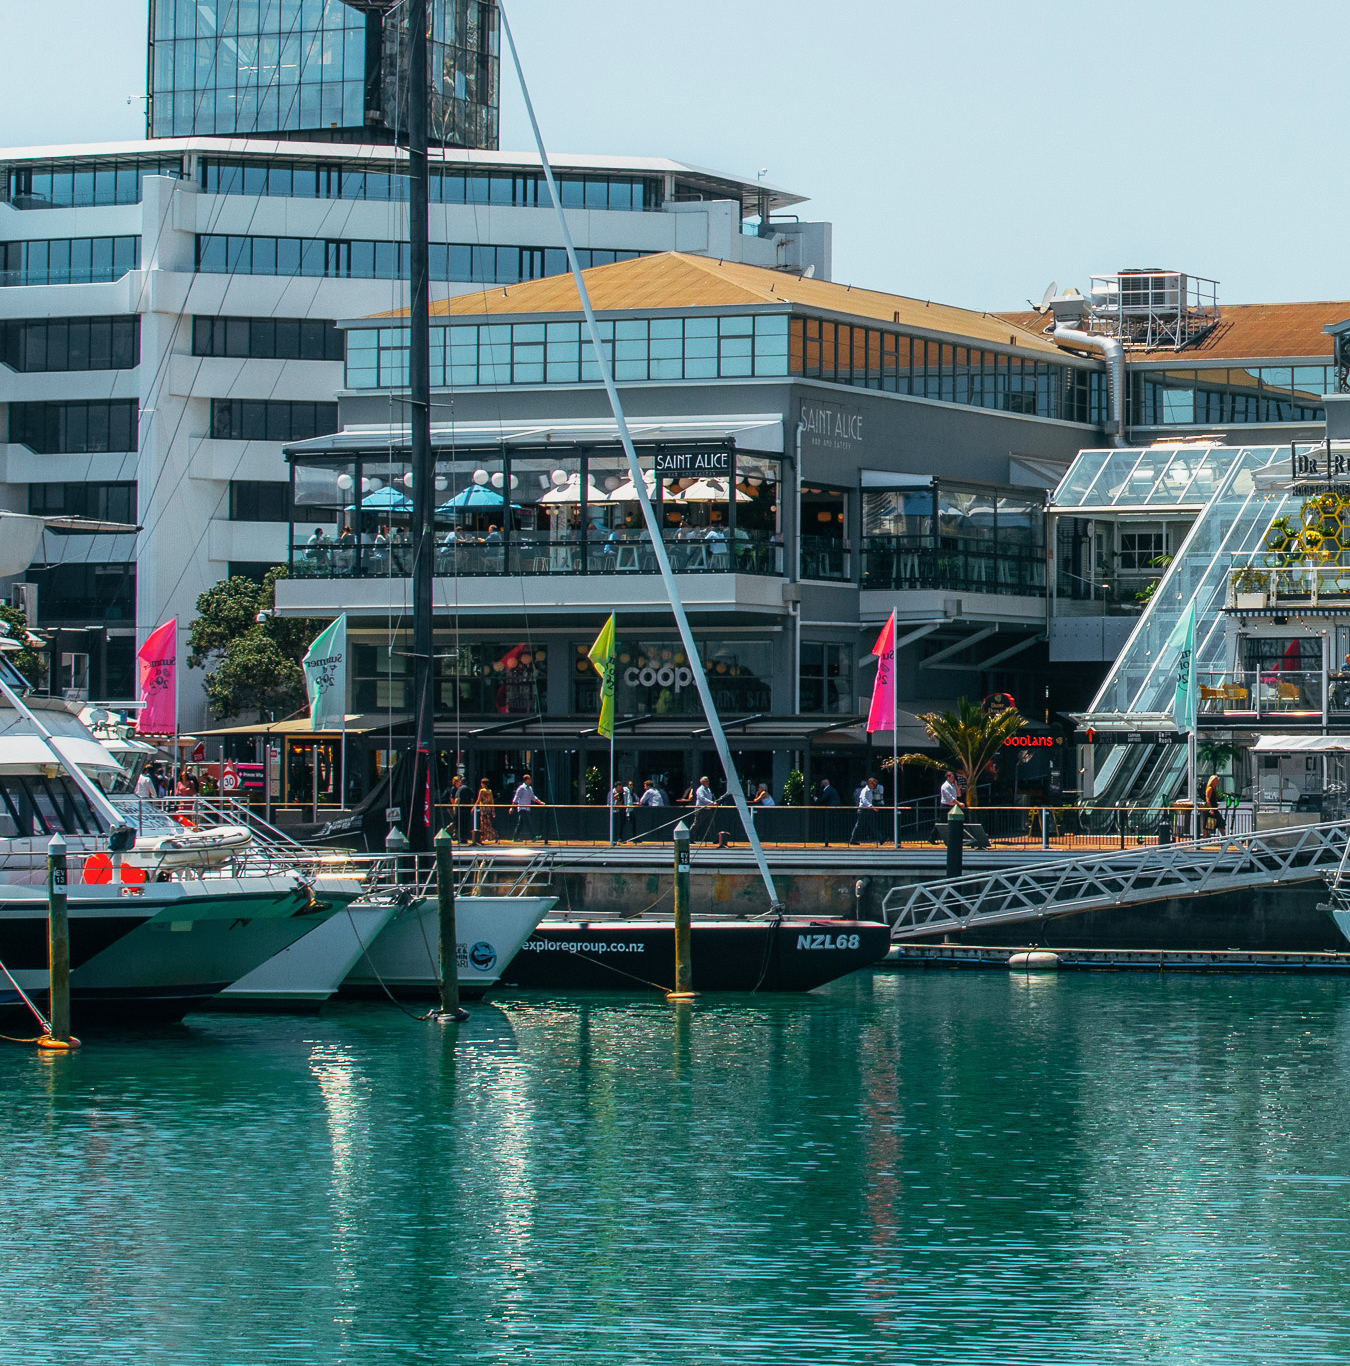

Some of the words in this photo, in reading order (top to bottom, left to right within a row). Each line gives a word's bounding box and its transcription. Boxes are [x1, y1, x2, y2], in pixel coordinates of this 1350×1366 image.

[802, 406, 832, 436] SAINT
[835, 412, 863, 440] ALICE
[656, 454, 692, 469] SAINT
[695, 454, 728, 469] ALICE
[224, 777, 234, 787] 30
[522, 939, 644, 954] exploregroup.co.nz
[797, 934, 860, 950] NZL68
